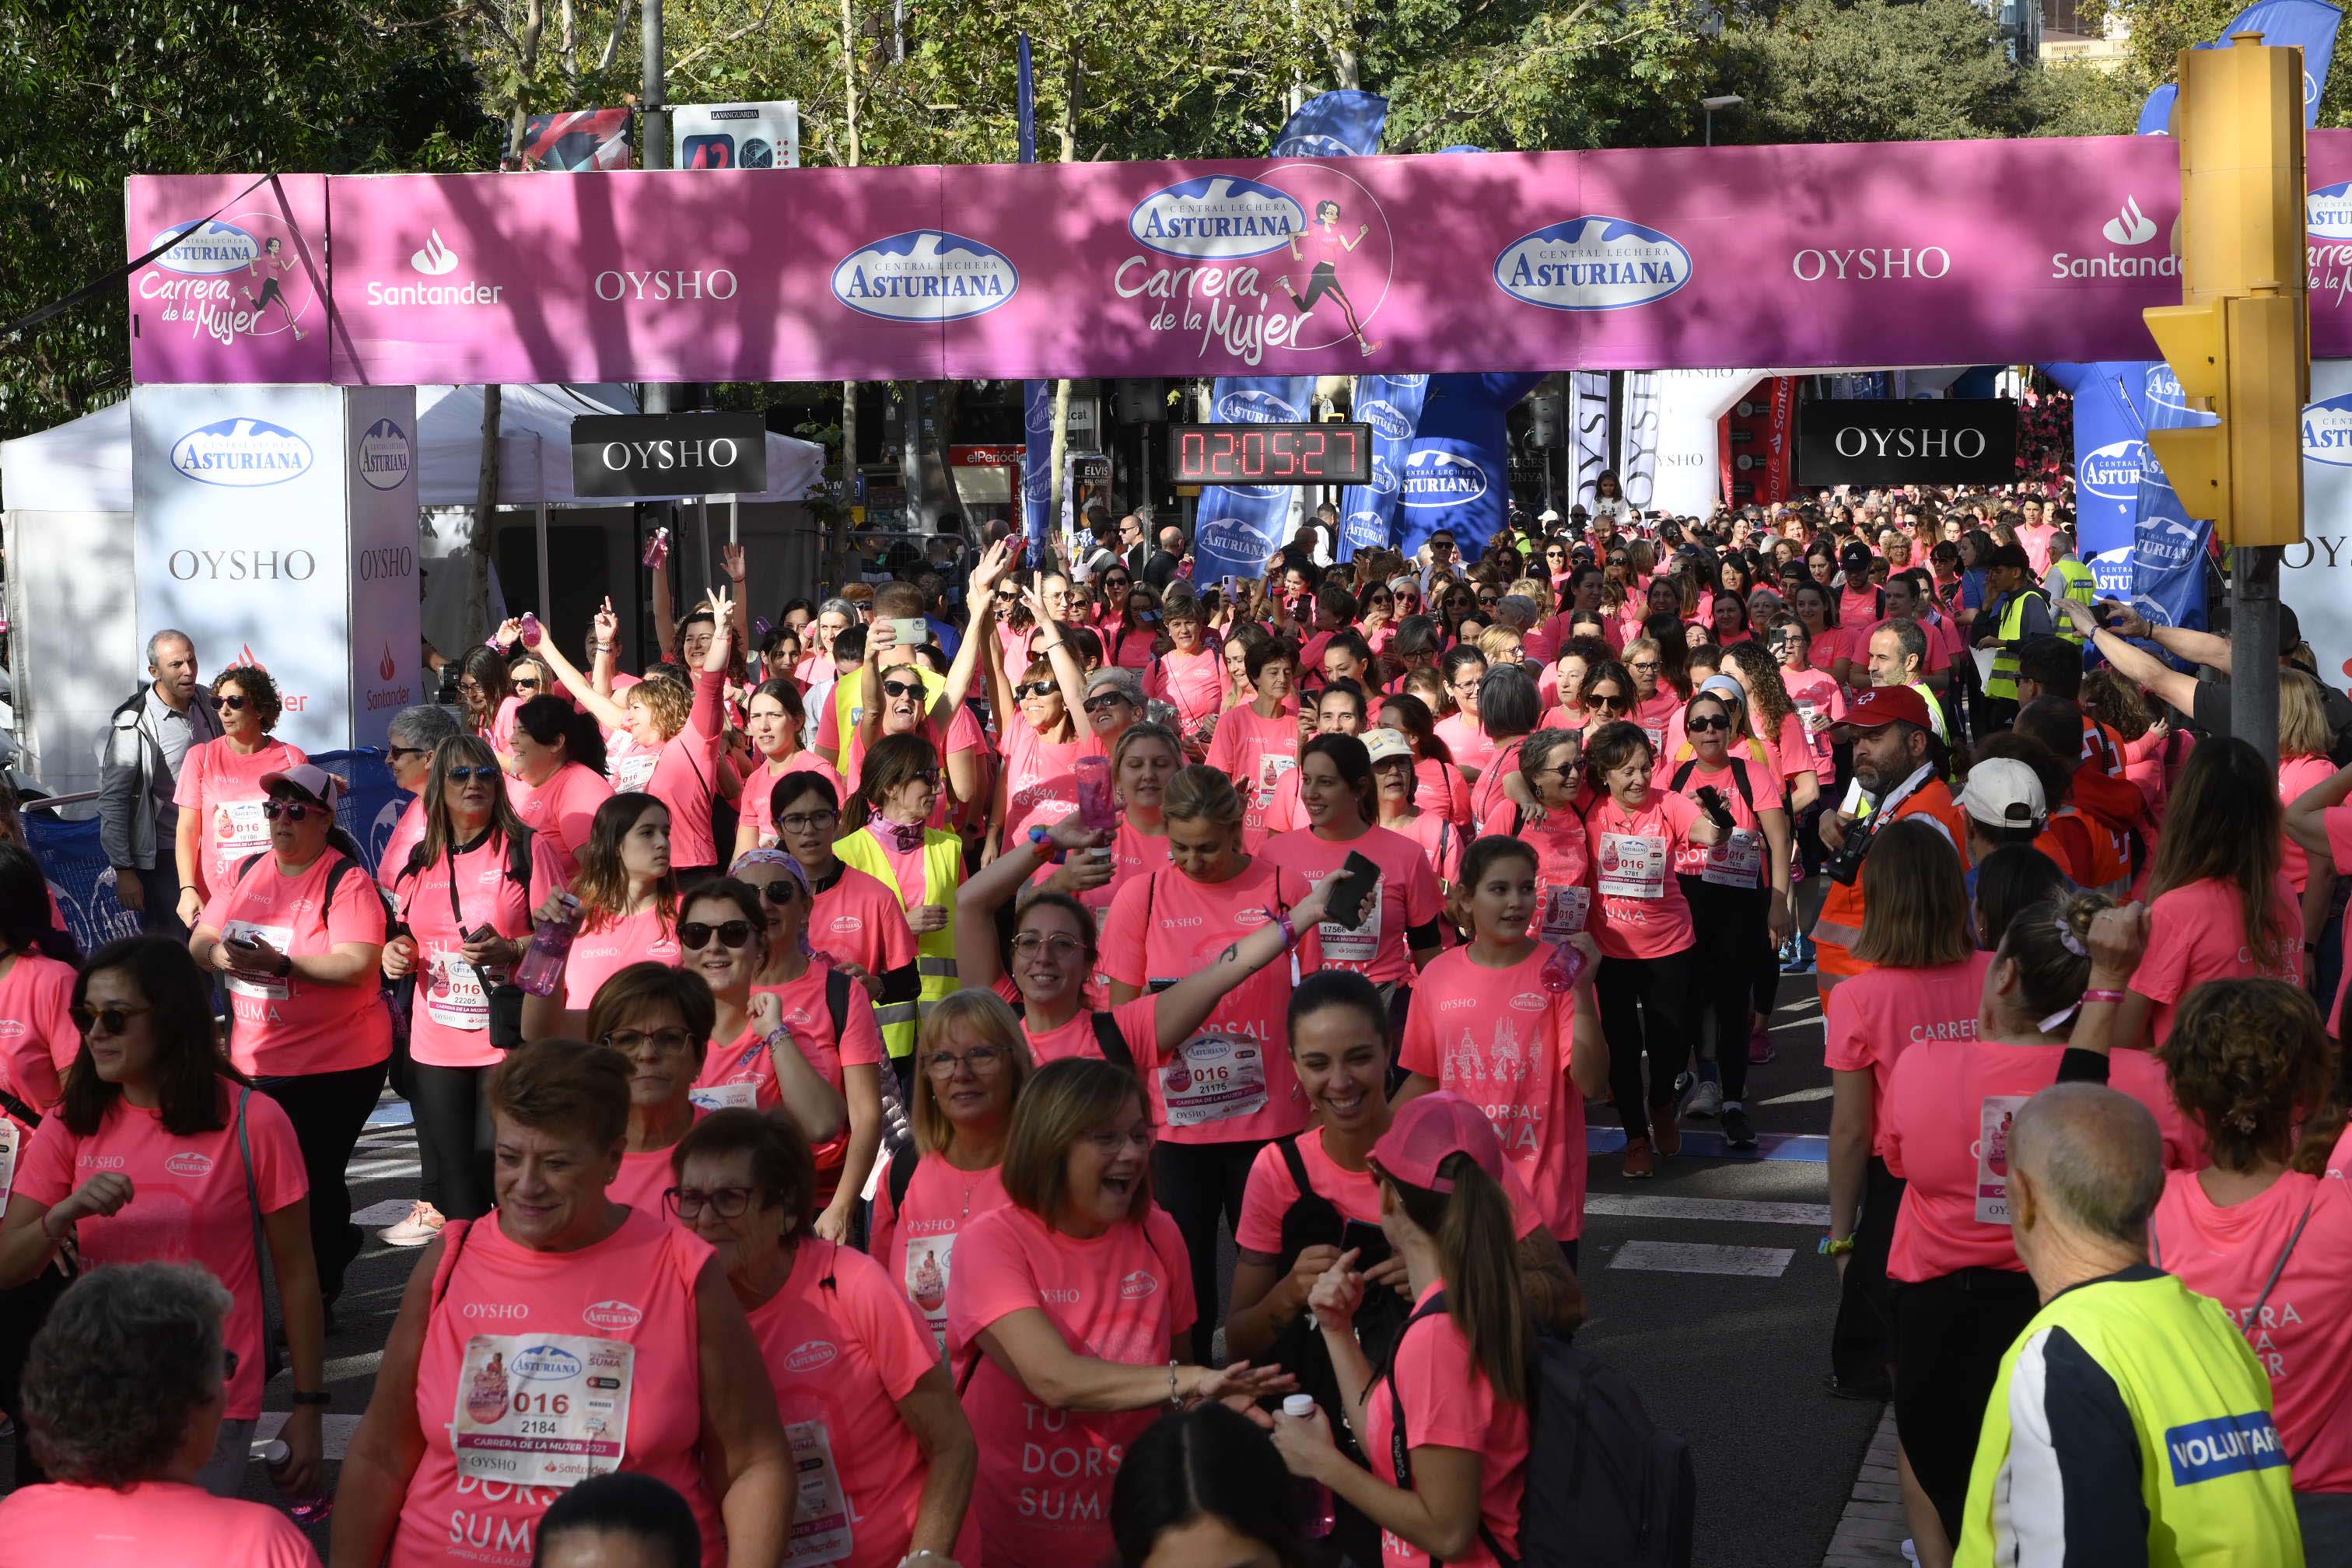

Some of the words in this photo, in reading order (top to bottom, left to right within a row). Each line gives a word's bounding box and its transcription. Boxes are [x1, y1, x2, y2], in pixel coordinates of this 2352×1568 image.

[1169, 204, 1226, 212] CENTRAL
[1230, 202, 1287, 212] LECHERA
[1142, 206, 1292, 239] ASTURIANA
[1540, 249, 1605, 259] CENTRAL
[1610, 247, 1671, 257] LECHERA
[1793, 246, 1951, 282] OYSHO
[874, 262, 935, 271] CENTRAL
[939, 261, 998, 271] LECHERA
[1115, 254, 1258, 299] Carrera
[1509, 251, 1677, 288] ASTURIANA
[2052, 252, 2182, 279] Santand
[138, 271, 230, 300] Carrera
[595, 269, 738, 301] OYSHO
[846, 264, 1003, 298] ASTURIANA
[366, 281, 503, 306] Santander
[162, 300, 179, 321] de
[182, 303, 194, 321] la
[192, 296, 266, 345] Mujer
[1150, 300, 1178, 332] de
[1183, 298, 1202, 331] la
[1199, 293, 1316, 366] Mujer
[1774, 376, 1789, 429] Santa
[1578, 371, 1608, 506] OYSH
[1625, 371, 1658, 510] OYSH
[1834, 425, 1986, 459] OYSHO
[2301, 419, 2352, 449] ASTU
[181, 443, 303, 470] ASTURIANA
[362, 446, 408, 474] ASTURIANA
[603, 438, 738, 471] OYSHO
[1181, 432, 1357, 476] 02:05:27
[1656, 453, 1704, 467] YSHO
[2086, 462, 2140, 485] ASTUR
[1400, 477, 1481, 494] STURIANA
[2280, 535, 2352, 569] OY
[168, 549, 316, 581] OYSHO
[359, 546, 411, 582] OYSHO
[2091, 567, 2133, 590] ASTU
[366, 686, 411, 712] Santander
[236, 823, 259, 833] 016
[1621, 859, 1644, 870] 016
[1675, 849, 1708, 863] DOR
[1728, 850, 1745, 860] 016
[1160, 915, 1202, 929] OYSHO
[1559, 909, 1574, 920] 016
[1605, 903, 1647, 923] UMA
[452, 982, 481, 996] 016
[454, 996, 477, 1005] 22205
[234, 999, 282, 1021] SUMA
[1440, 998, 1477, 1011] OYSHO
[1910, 1018, 1979, 1043] CARRER
[1194, 1066, 1229, 1083] 016
[1199, 1083, 1227, 1094] 21175
[1175, 1110, 1206, 1120] OYSHO
[1478, 1104, 1542, 1121] ORSAL
[907, 1218, 956, 1233] OYSHO
[1041, 1287, 1080, 1305] YSHO
[463, 1303, 529, 1320] OYSHO
[587, 1310, 639, 1324] ASTURIANA
[516, 1360, 576, 1374] ASTURIANA
[588, 1357, 621, 1369] SUMA
[513, 1391, 570, 1415] 016
[520, 1420, 557, 1435] 2184
[1021, 1402, 1067, 1433] TU
[473, 1437, 517, 1448] CARRERA
[519, 1440, 534, 1450] DE
[534, 1440, 548, 1451] LA
[548, 1440, 583, 1452] MUJER
[790, 1440, 817, 1453] UMA
[471, 1455, 516, 1472] OYSHO
[1021, 1443, 1123, 1478] DORS
[1018, 1487, 1112, 1521] SUM
[449, 1509, 532, 1554] SUM
[502, 1556, 533, 1568] MUJE
